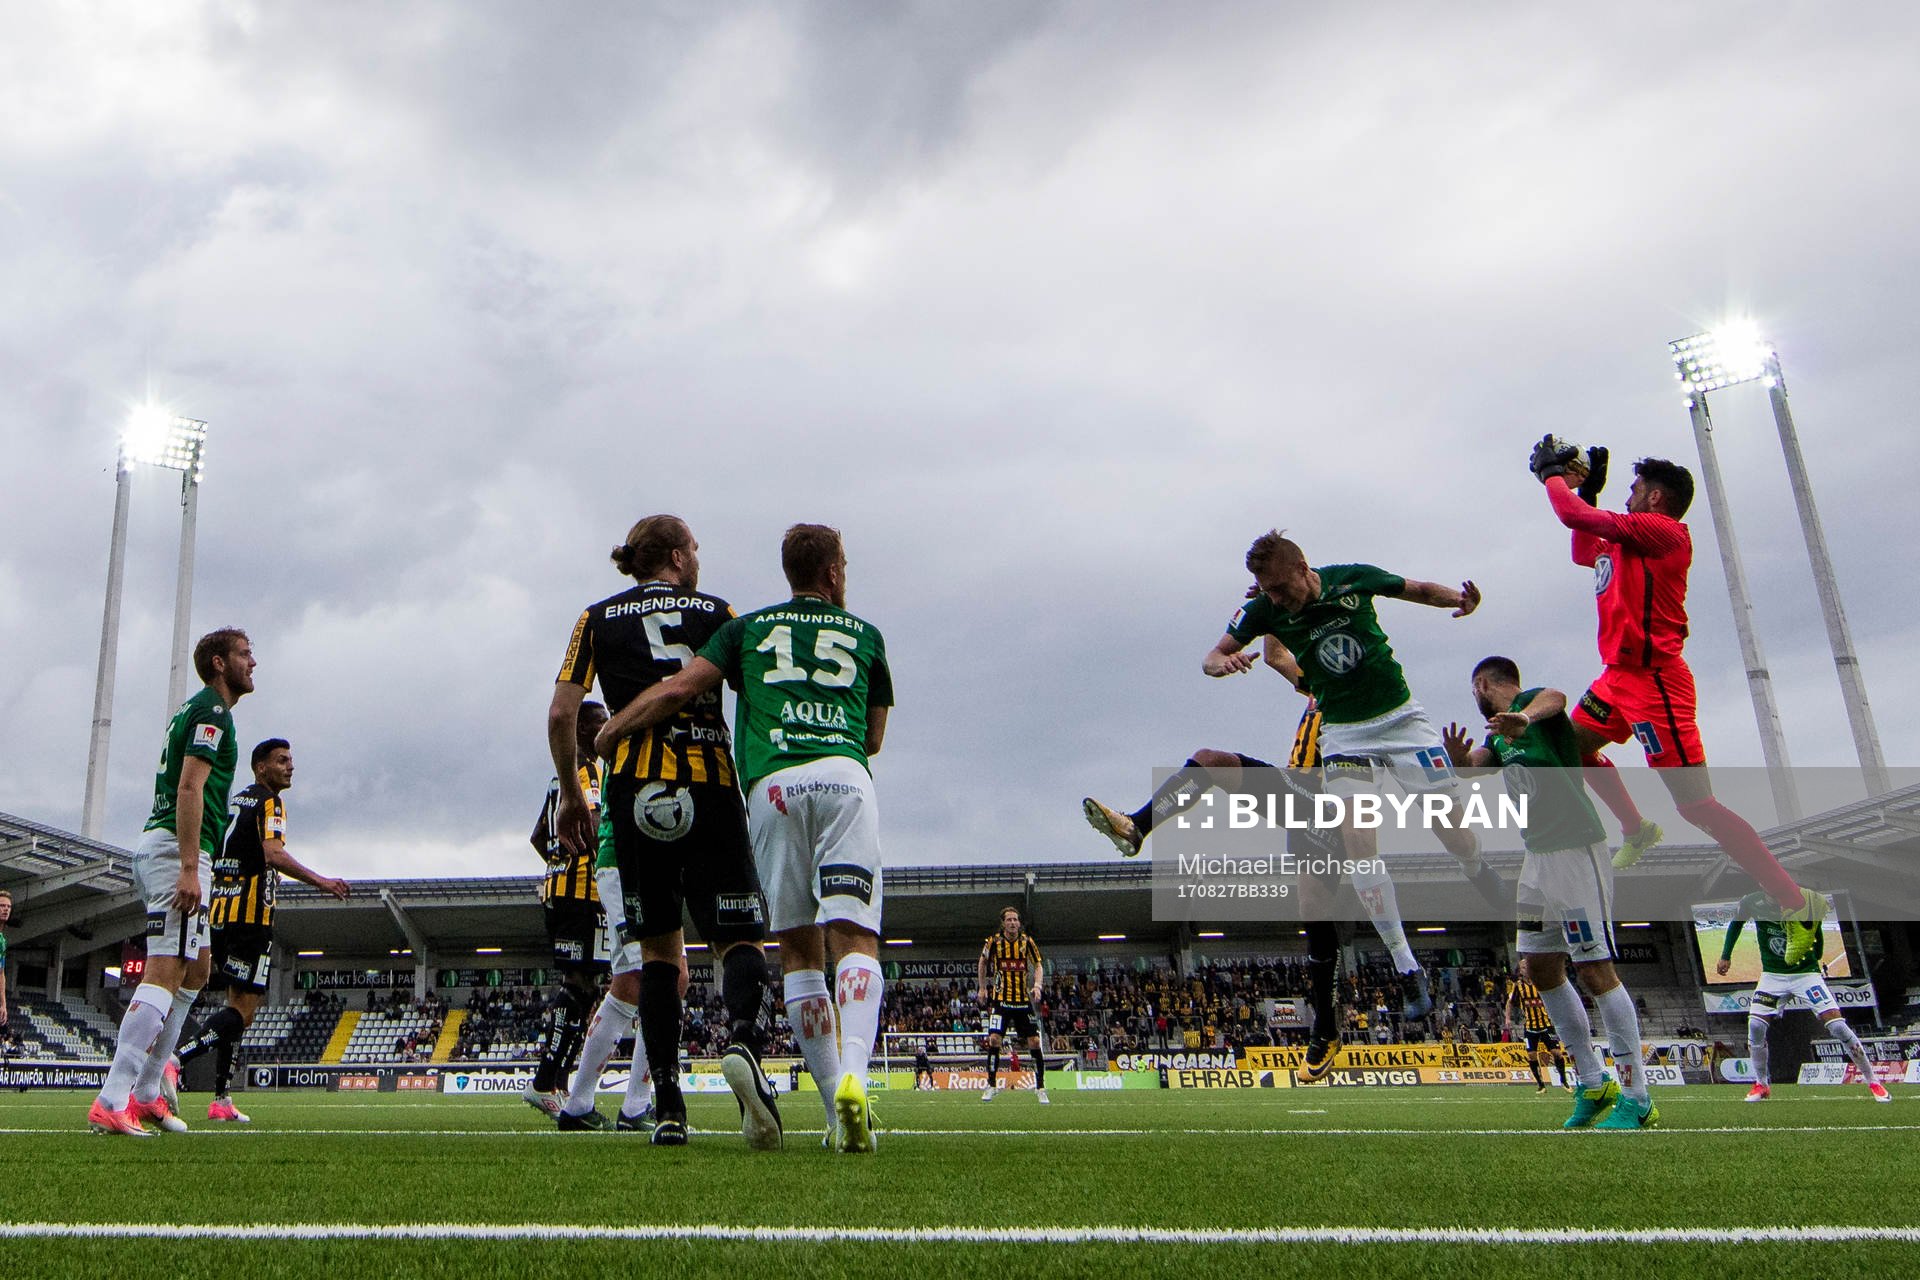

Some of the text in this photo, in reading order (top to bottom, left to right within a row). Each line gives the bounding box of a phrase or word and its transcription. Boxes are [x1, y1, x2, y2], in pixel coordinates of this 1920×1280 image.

[605, 597, 715, 619] EHRENBORG
[755, 612, 864, 633] AASMUNDSEN
[642, 611, 695, 682] 5
[756, 625, 857, 688] 15
[781, 700, 848, 724] AQUA
[1326, 760, 1370, 774] dizparc
[786, 781, 864, 798] Riksbyggen
[190, 937, 198, 948] 6
[1623, 947, 1653, 960] PARK
[905, 961, 978, 975] SANKT JÖRGE
[318, 975, 351, 985] SANKT
[352, 972, 394, 985] JÖRGEN
[1835, 990, 1872, 1004] ROUP
[1116, 1053, 1237, 1071] GETINGARNA
[1348, 1049, 1425, 1067] HÄCKEN
[10, 1068, 45, 1085] UTANFÖR.
[46, 1071, 54, 1085] VI
[54, 1068, 64, 1085] ÄR
[342, 1080, 377, 1088] BRA
[400, 1079, 436, 1087] BRA
[947, 1074, 1006, 1089] Renoa
[1076, 1072, 1122, 1090] Lendo
[1179, 1070, 1254, 1088] EHRAB
[1330, 1070, 1418, 1086] XL-BYGG
[1462, 1071, 1507, 1080] HECO
[1644, 1066, 1677, 1085] gab
